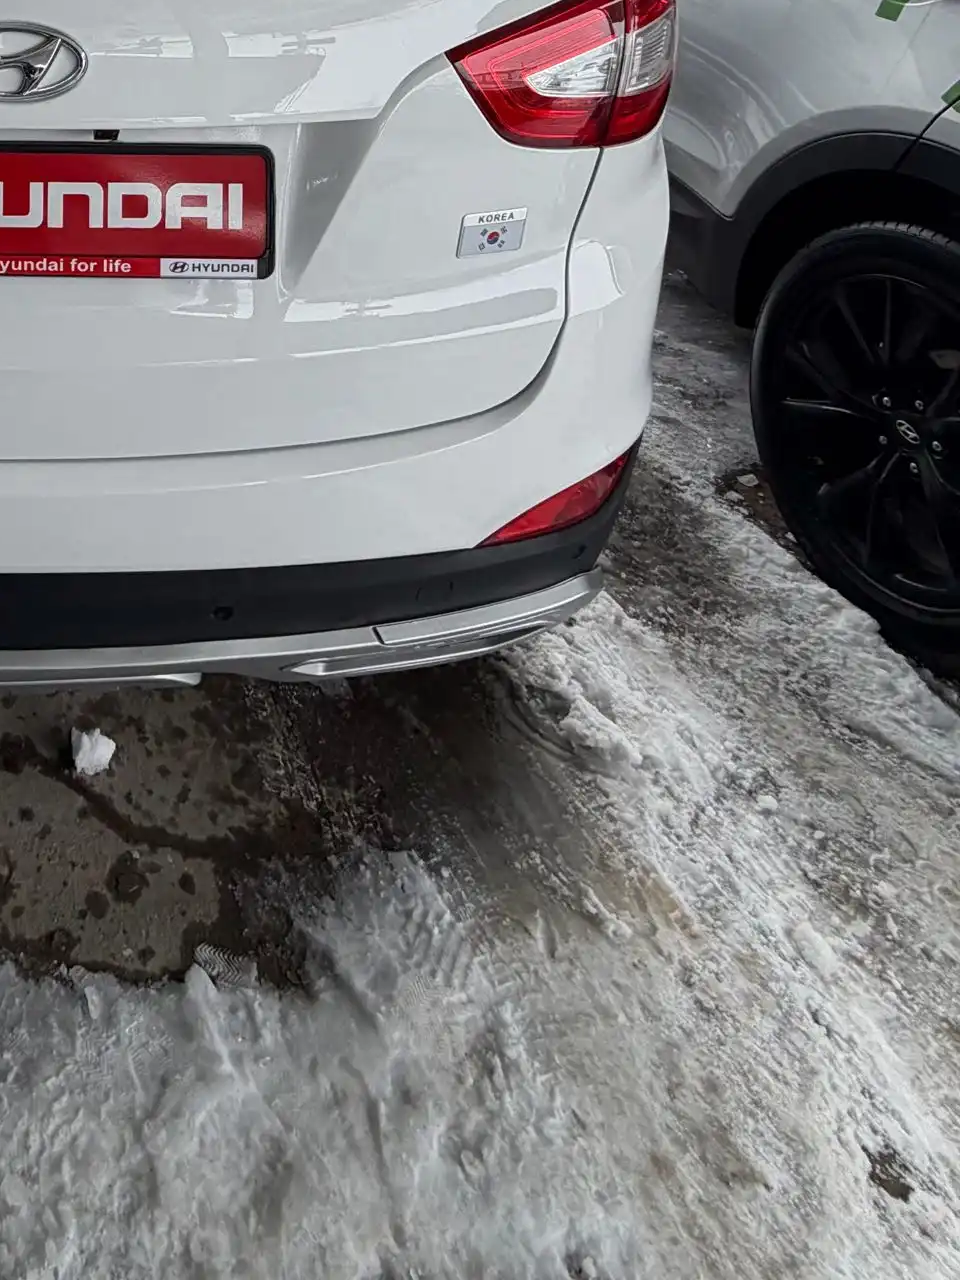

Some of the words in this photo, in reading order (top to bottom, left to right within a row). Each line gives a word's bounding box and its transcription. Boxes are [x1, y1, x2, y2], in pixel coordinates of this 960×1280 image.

[478, 212, 515, 224] KOREA
[70, 259, 97, 272] for
[103, 259, 132, 273] life
[191, 263, 254, 273] HYUNDAI
